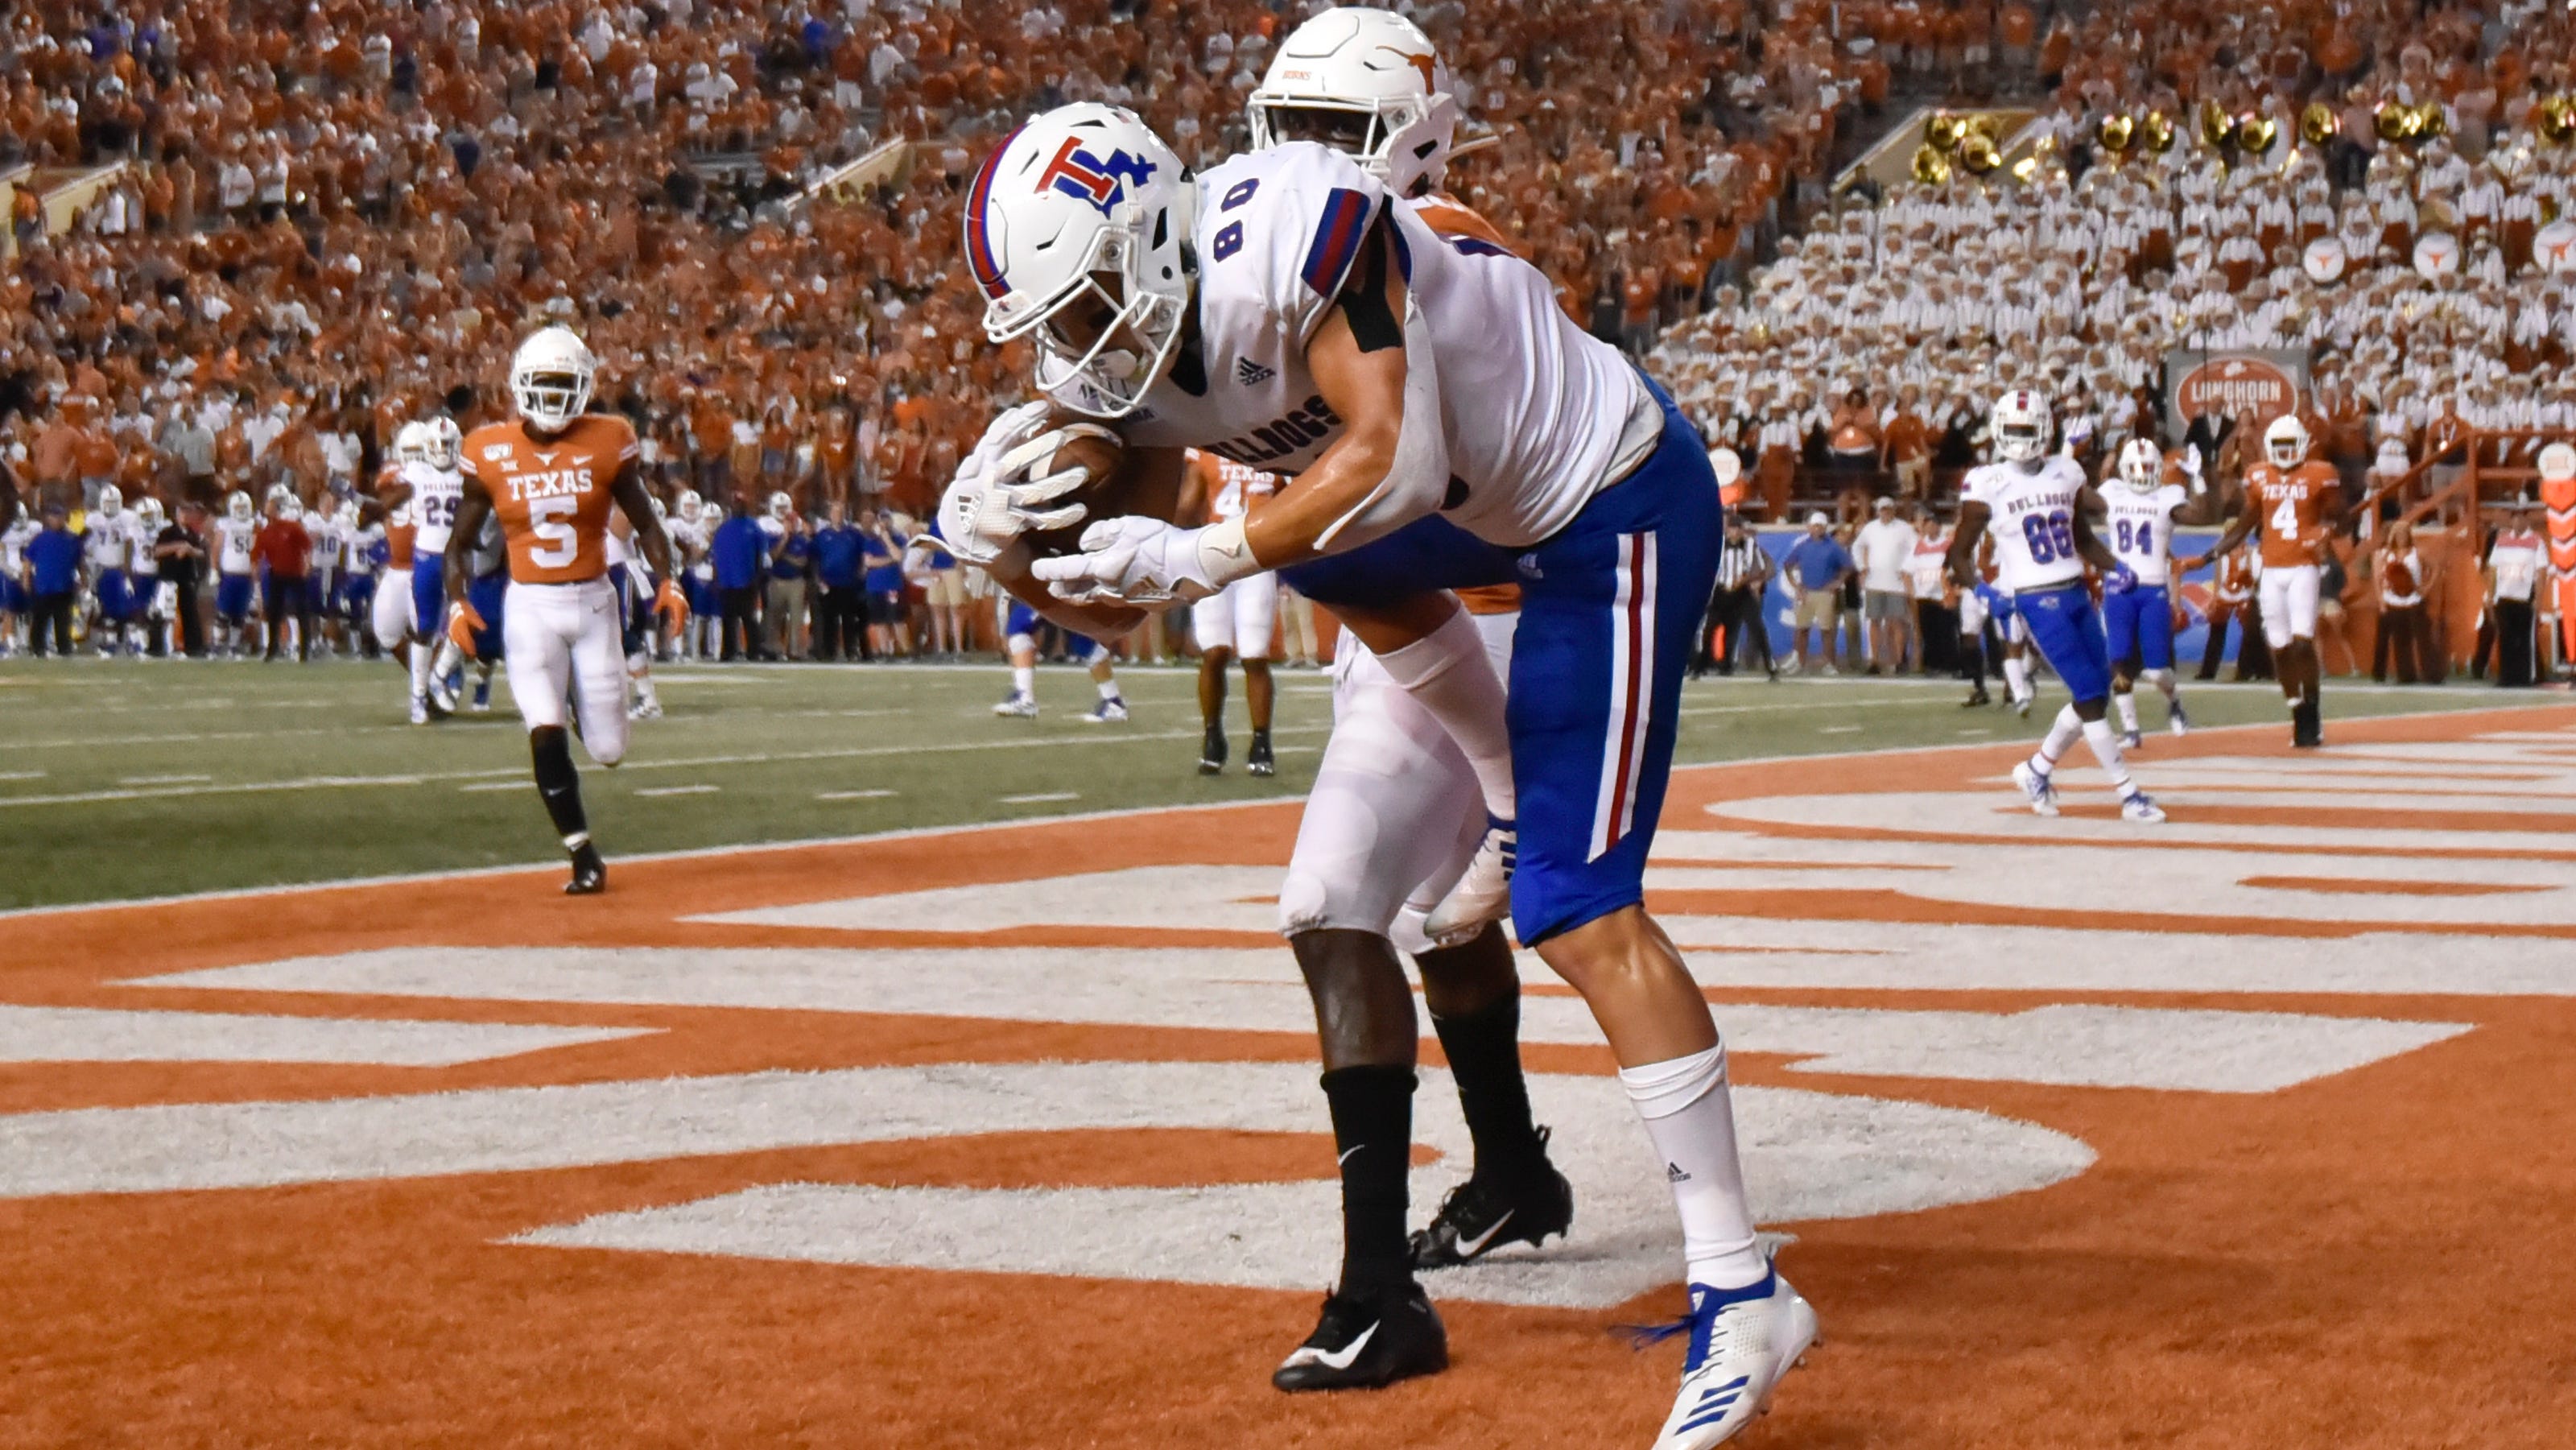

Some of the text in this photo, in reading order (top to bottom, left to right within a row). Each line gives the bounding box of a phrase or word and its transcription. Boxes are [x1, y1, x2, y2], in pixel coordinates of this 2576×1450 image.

[506, 469, 593, 502] TEXAS
[2261, 484, 2308, 500] TEXAS
[529, 494, 578, 568] 5
[2116, 518, 2153, 556] 84
[2271, 498, 2298, 540] 4
